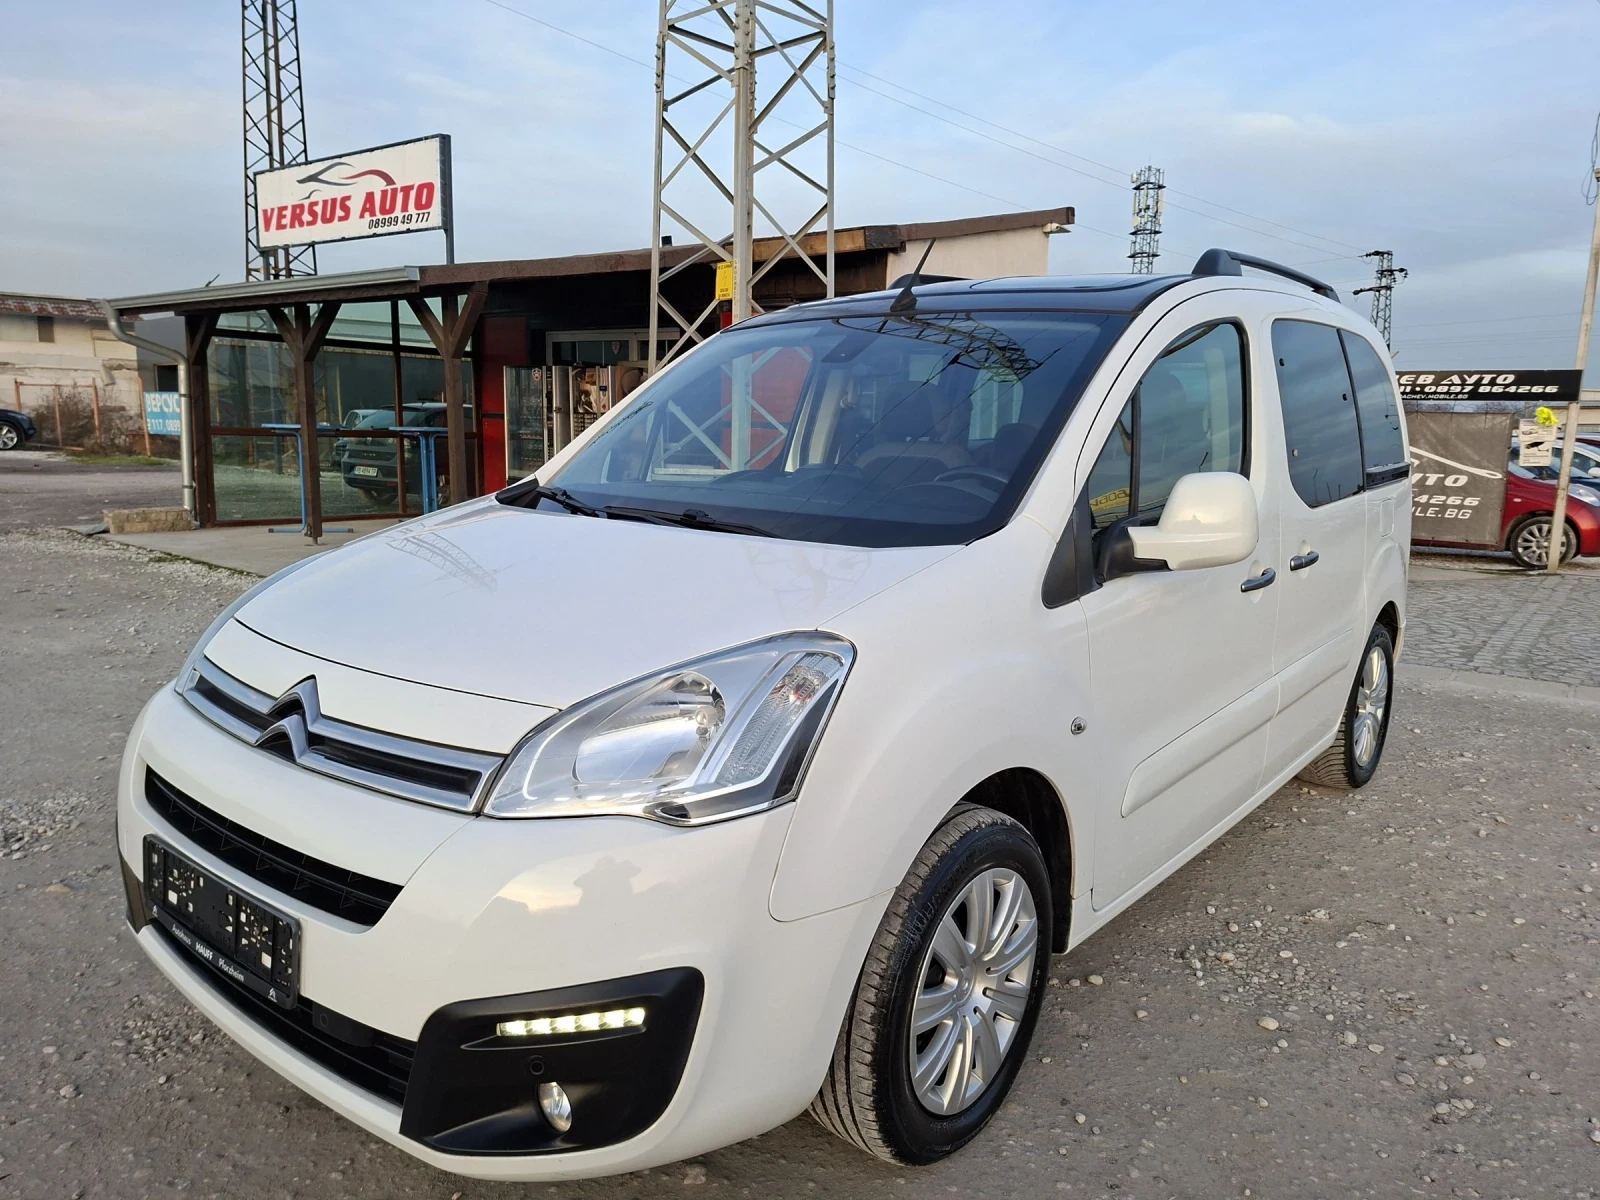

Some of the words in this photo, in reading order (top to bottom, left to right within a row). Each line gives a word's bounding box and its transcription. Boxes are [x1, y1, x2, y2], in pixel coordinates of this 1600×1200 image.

[262, 195, 352, 233] VERSUS
[359, 182, 435, 219] AUTO
[368, 215, 399, 230] 08999
[400, 213, 413, 225] 49
[415, 211, 431, 224] 777
[1424, 385, 1474, 393] 0897
[1478, 385, 1560, 393] 864266
[1412, 494, 1482, 506] 4266
[195, 941, 214, 961] HAUFF
[218, 957, 245, 983] Pforzheim
